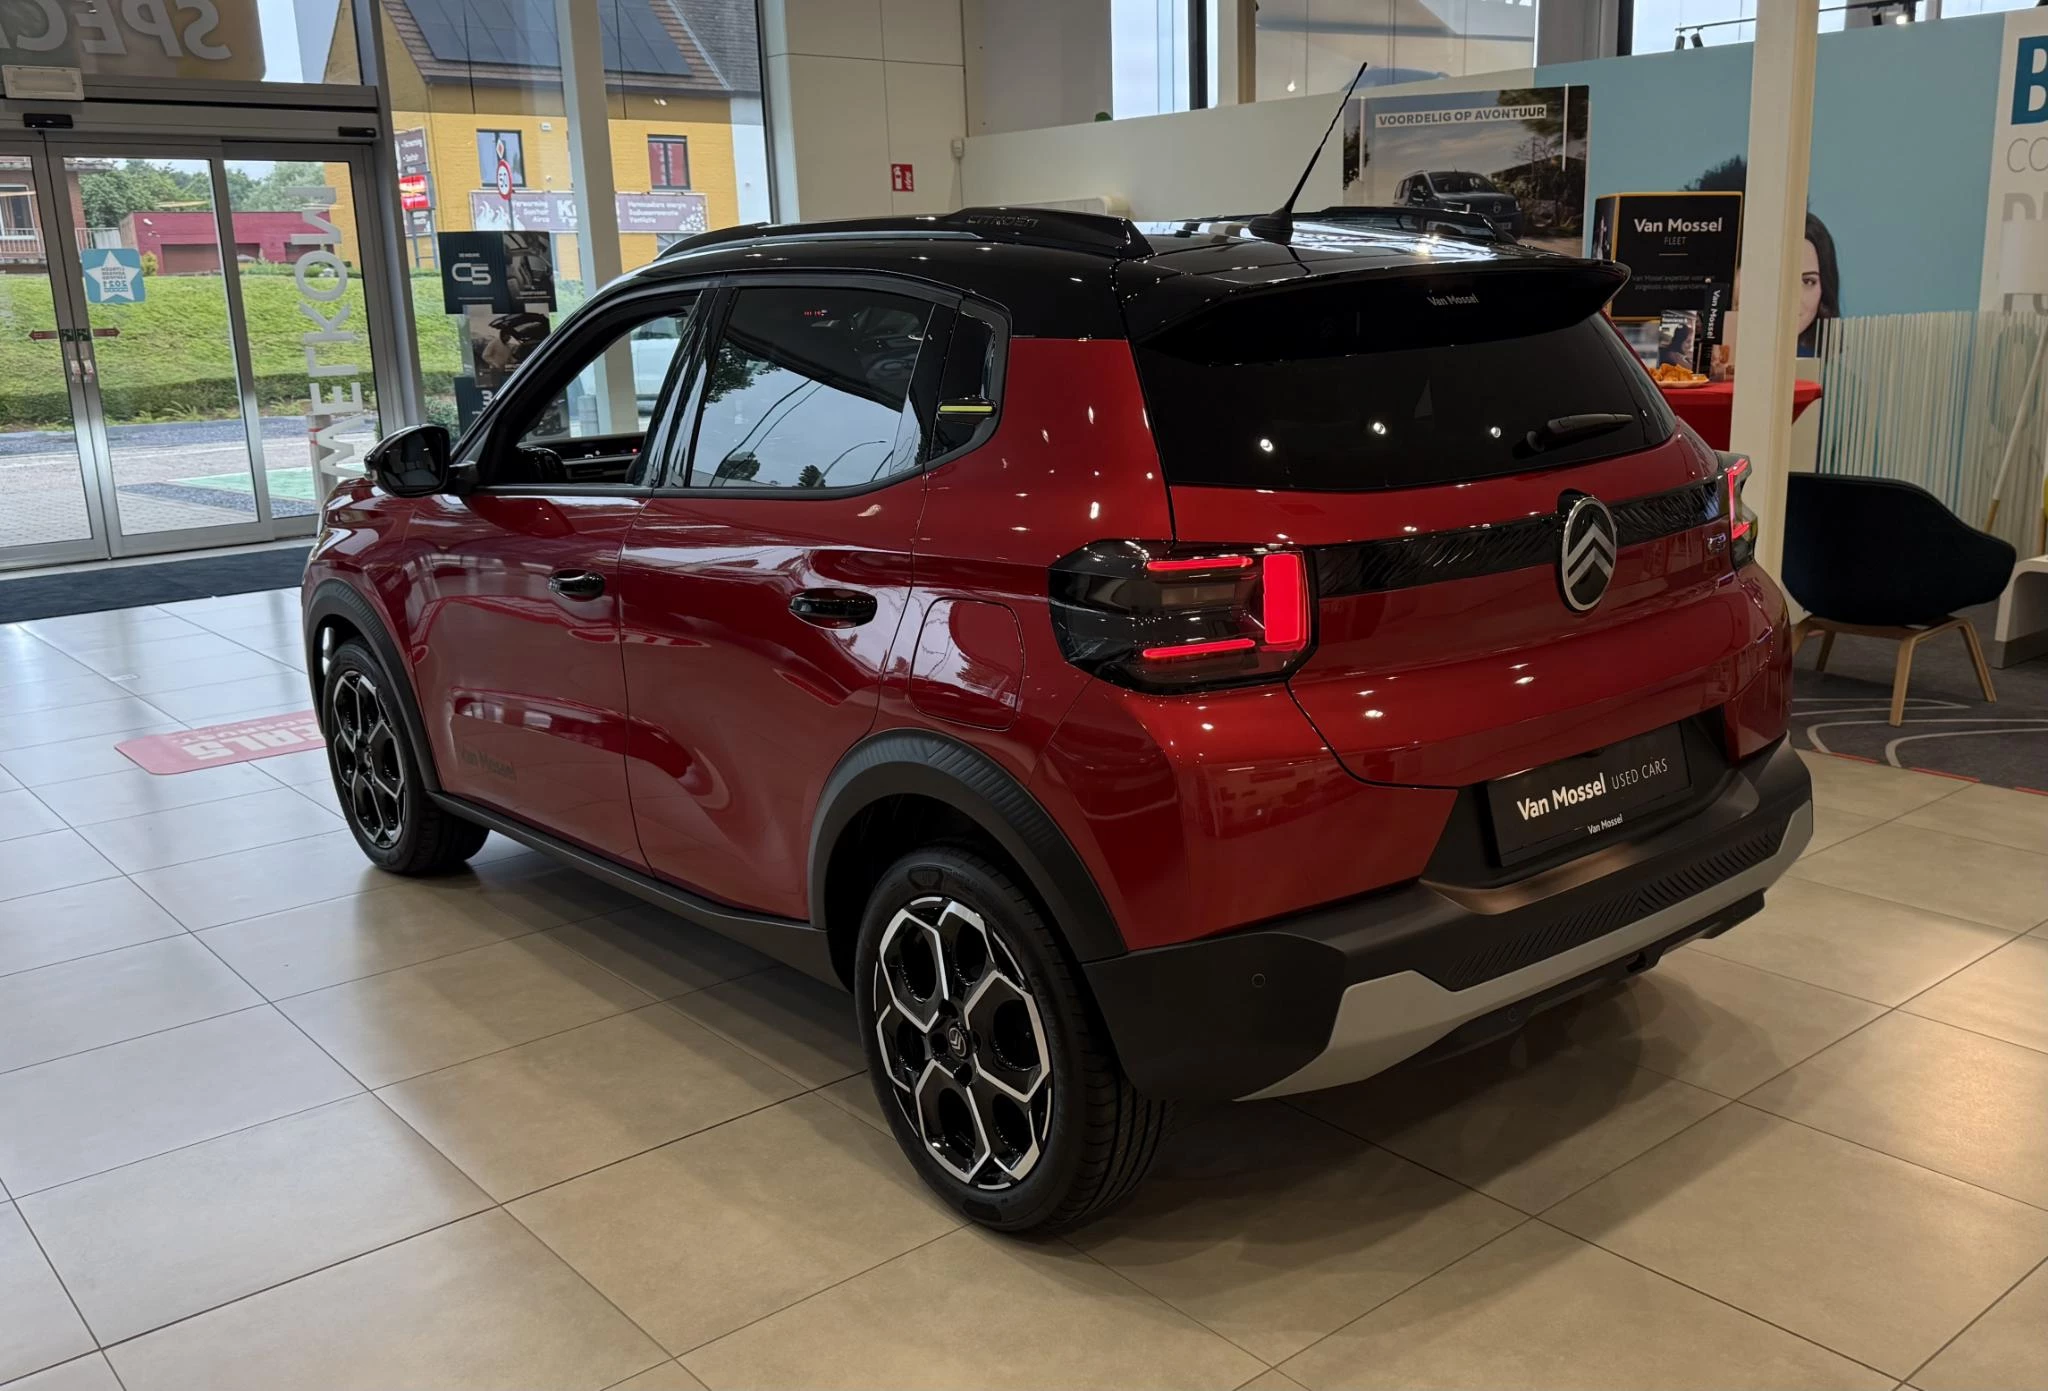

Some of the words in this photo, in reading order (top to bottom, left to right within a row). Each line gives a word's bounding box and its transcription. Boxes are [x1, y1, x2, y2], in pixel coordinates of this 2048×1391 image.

[1379, 111, 1452, 126] VOORDELIG
[1454, 110, 1472, 122] OP
[1475, 106, 1545, 121] AVONTUUR
[1633, 217, 1663, 233] Van
[1667, 216, 1723, 233] Mossel
[1663, 236, 1688, 246] FLEET
[1426, 295, 1448, 306] Van
[1446, 292, 1479, 305] Mossel
[1711, 289, 1721, 307] Van
[1707, 308, 1718, 339] Mossel
[182, 722, 326, 761] EALS
[1516, 797, 1550, 821] Van
[1551, 772, 1607, 810] Mossel
[1611, 768, 1639, 790] USED
[1641, 758, 1668, 779] CARS
[1587, 821, 1601, 835] Van
[1601, 813, 1624, 831] Mossel
